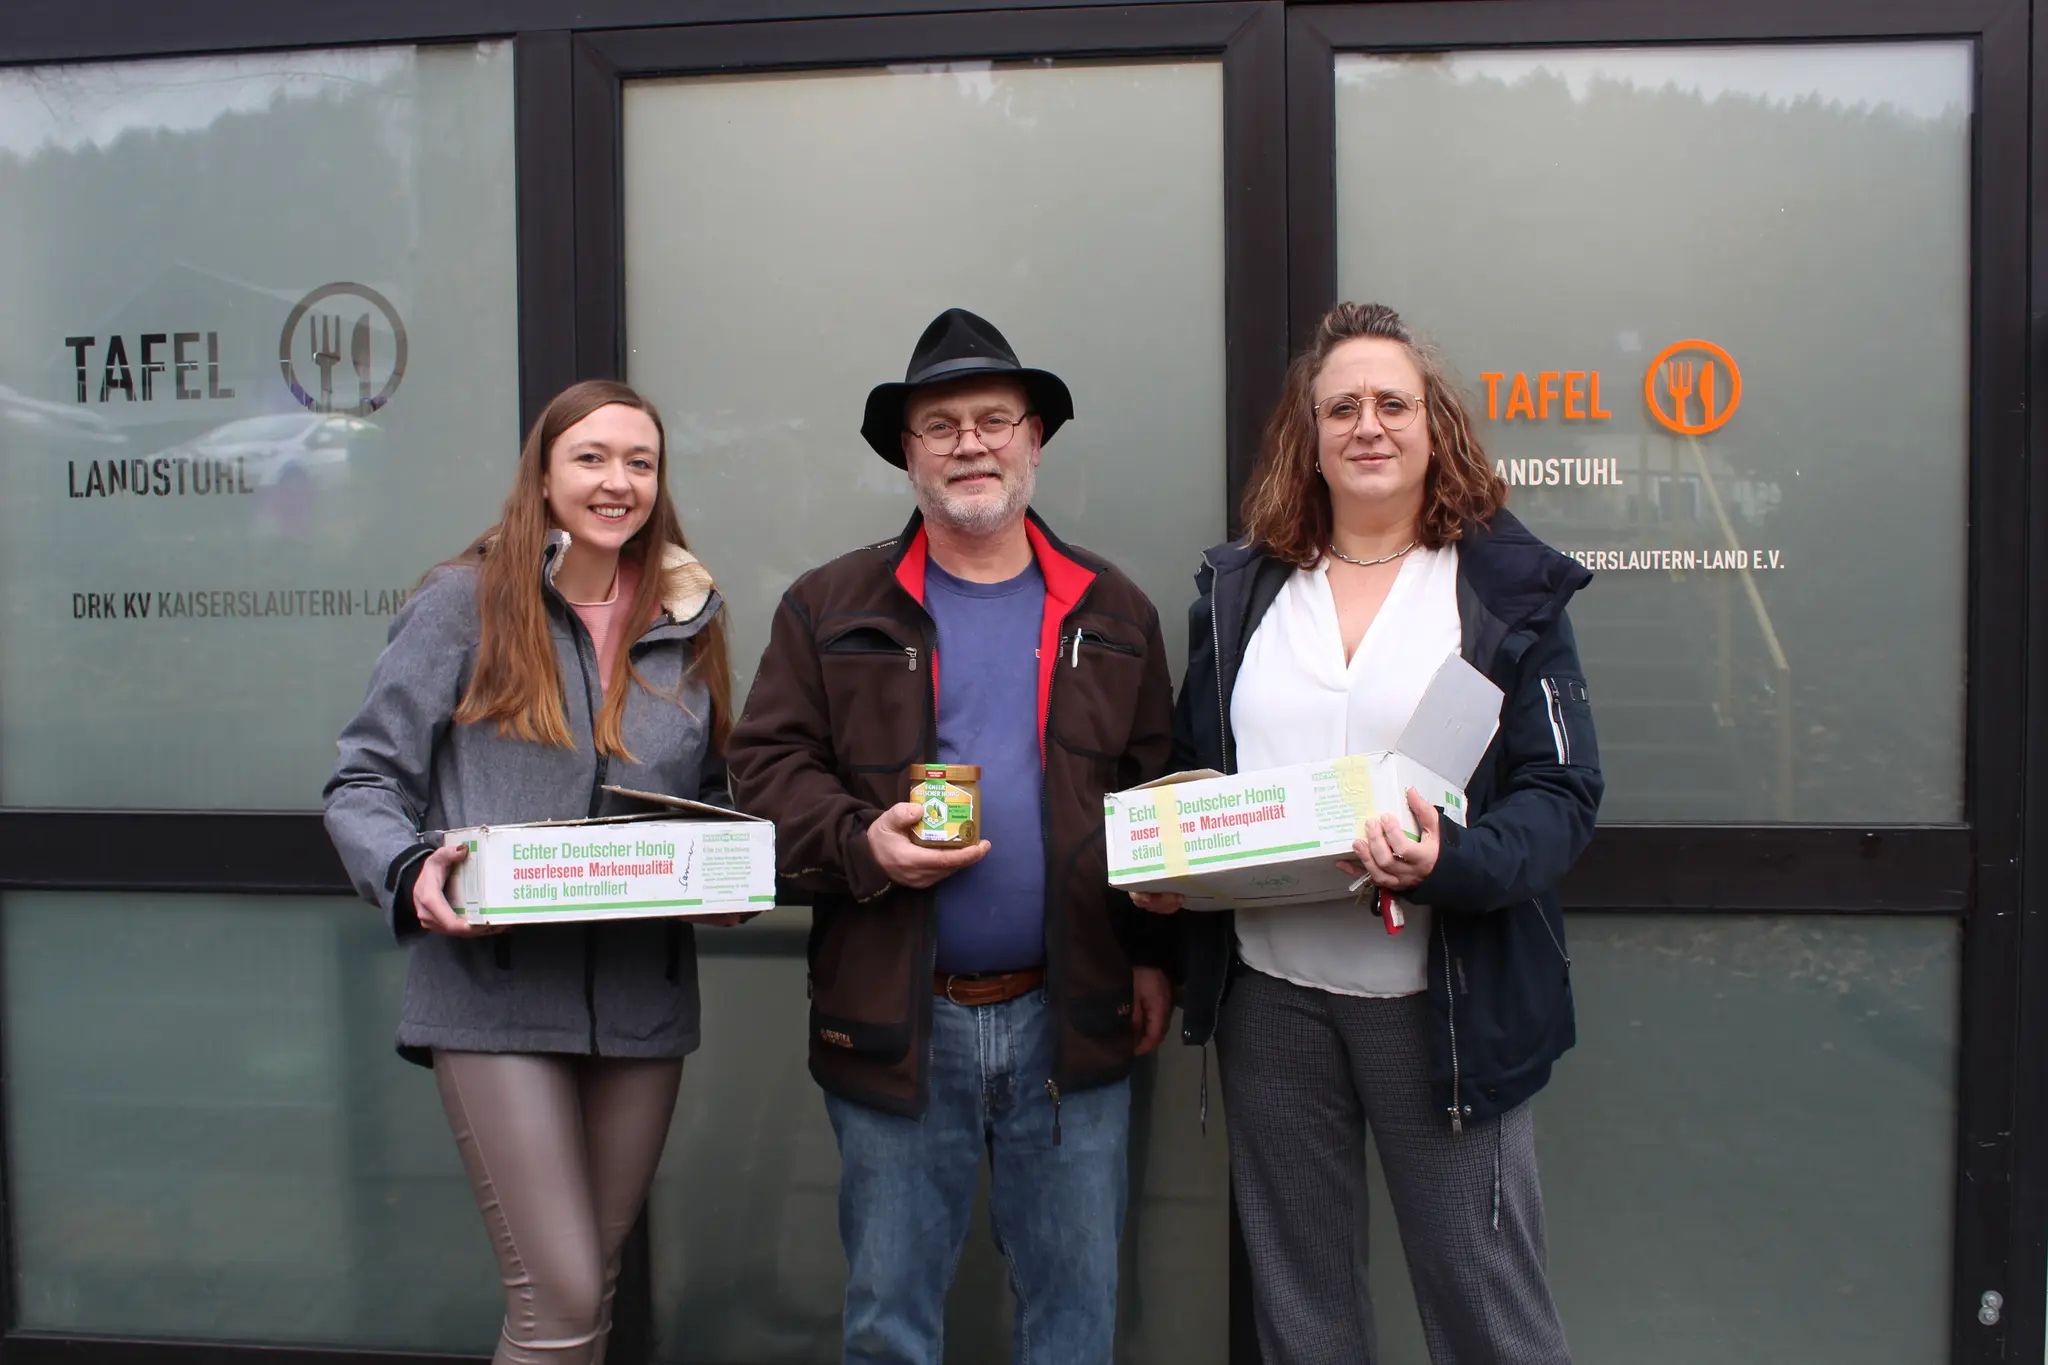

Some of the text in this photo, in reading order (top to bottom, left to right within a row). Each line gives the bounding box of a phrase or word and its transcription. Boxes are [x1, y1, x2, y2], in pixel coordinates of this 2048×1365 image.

[65, 331, 236, 404] TAFEL
[1480, 371, 1612, 419] TAFEL
[68, 456, 254, 498] LANDSTUHL
[1494, 458, 1623, 486] ANDSTUHL
[1562, 549, 1785, 570] SERSLAUTERN-LAND E.V.
[72, 588, 408, 619] DRK KV KAISERSLAUTERN-LAN
[1128, 803, 1159, 823] Echt
[1244, 784, 1286, 804] Honig
[1130, 821, 1196, 842] auserne
[1200, 803, 1286, 831] Markenqualität
[513, 839, 675, 861] Echter Deutscher Honig
[1132, 830, 1242, 861] ständ ontrolliert
[513, 859, 674, 881] auserlesene Markenqualität
[513, 880, 628, 901] ständig kontrolliert
